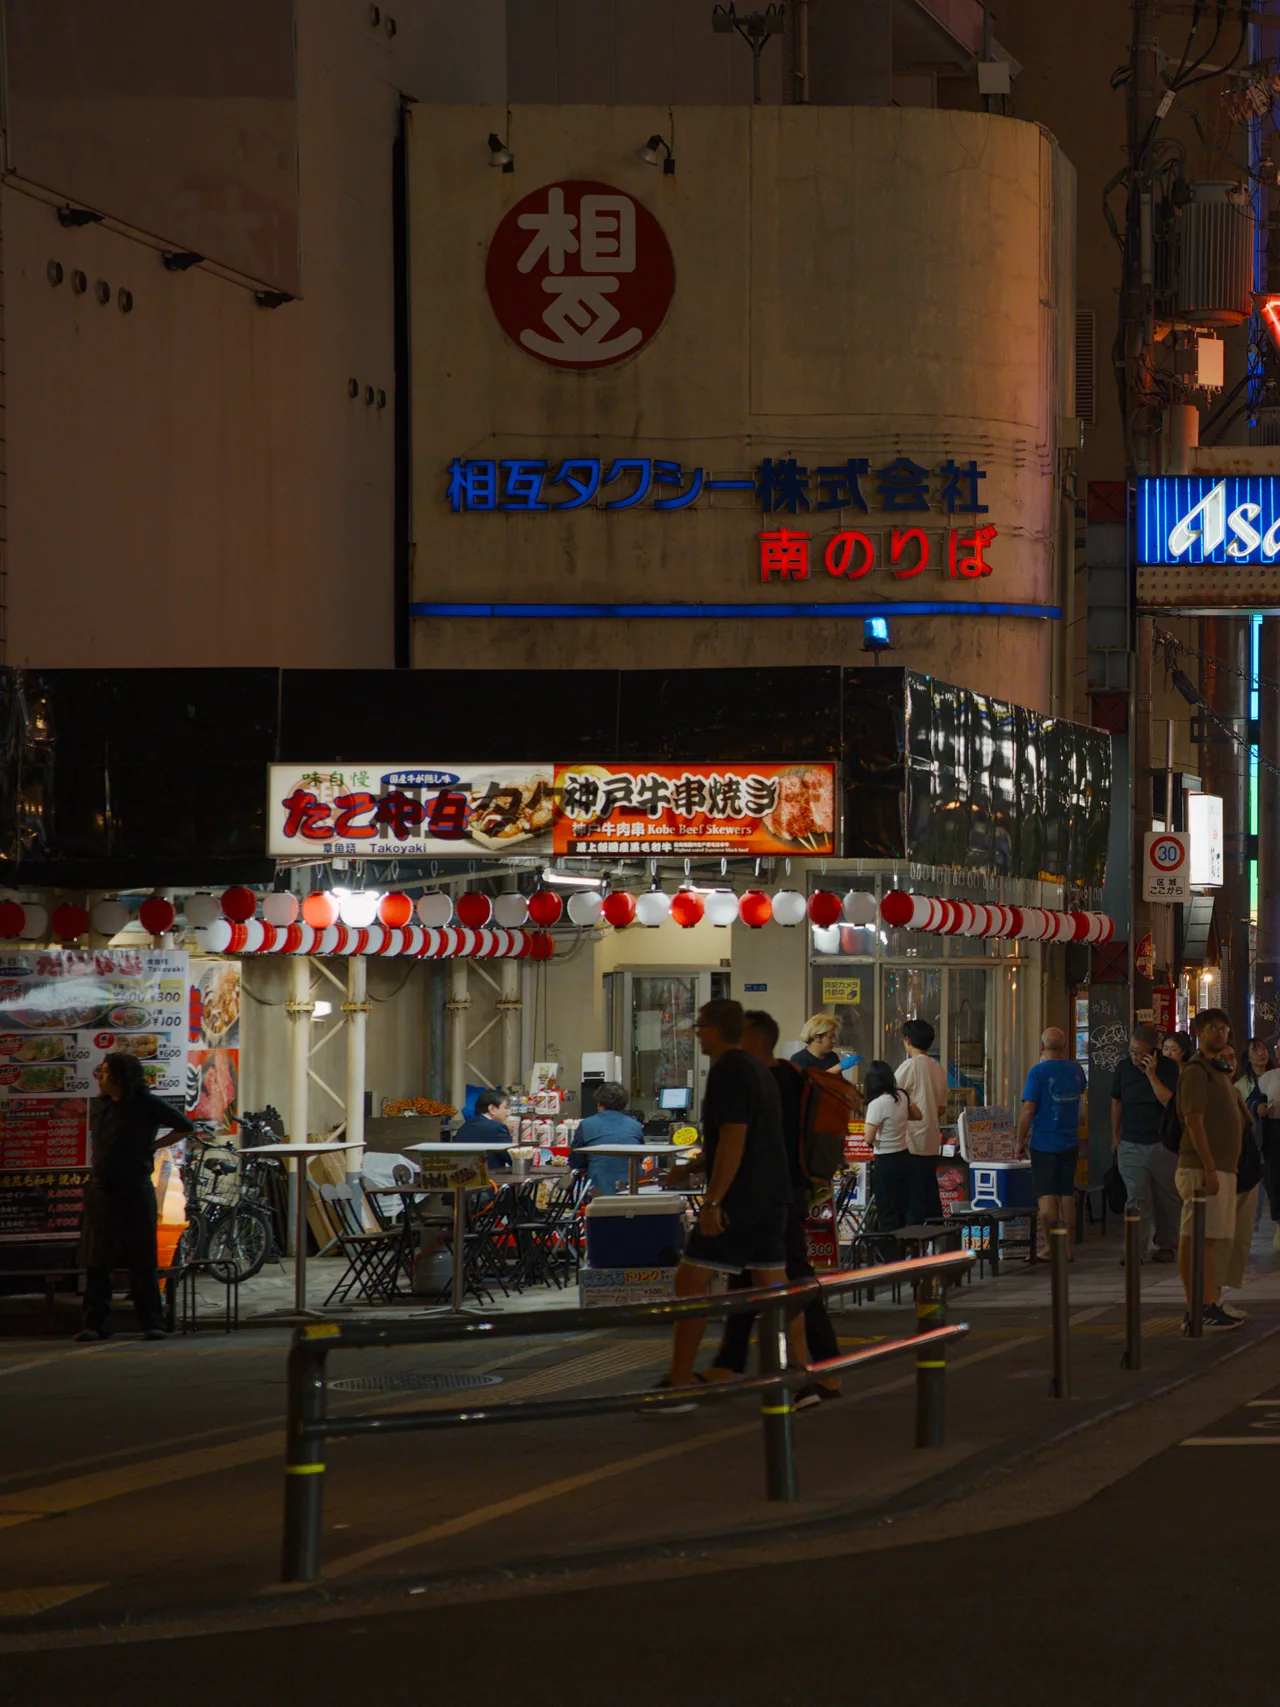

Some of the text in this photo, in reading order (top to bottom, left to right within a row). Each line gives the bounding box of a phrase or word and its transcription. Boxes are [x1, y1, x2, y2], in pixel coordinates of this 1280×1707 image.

[447, 458, 989, 513] 相互タクシー株式会社
[758, 524, 998, 581] 南のりば
[302, 770, 370, 788] 味自慢
[565, 773, 778, 819] 神戸牛串焼き
[648, 822, 677, 834] Kobe
[679, 822, 704, 834] Beef
[706, 822, 752, 834] Skewers
[370, 843, 427, 855] Takoyaki
[1158, 846, 1177, 862] 30
[1150, 886, 1184, 895] ここから
